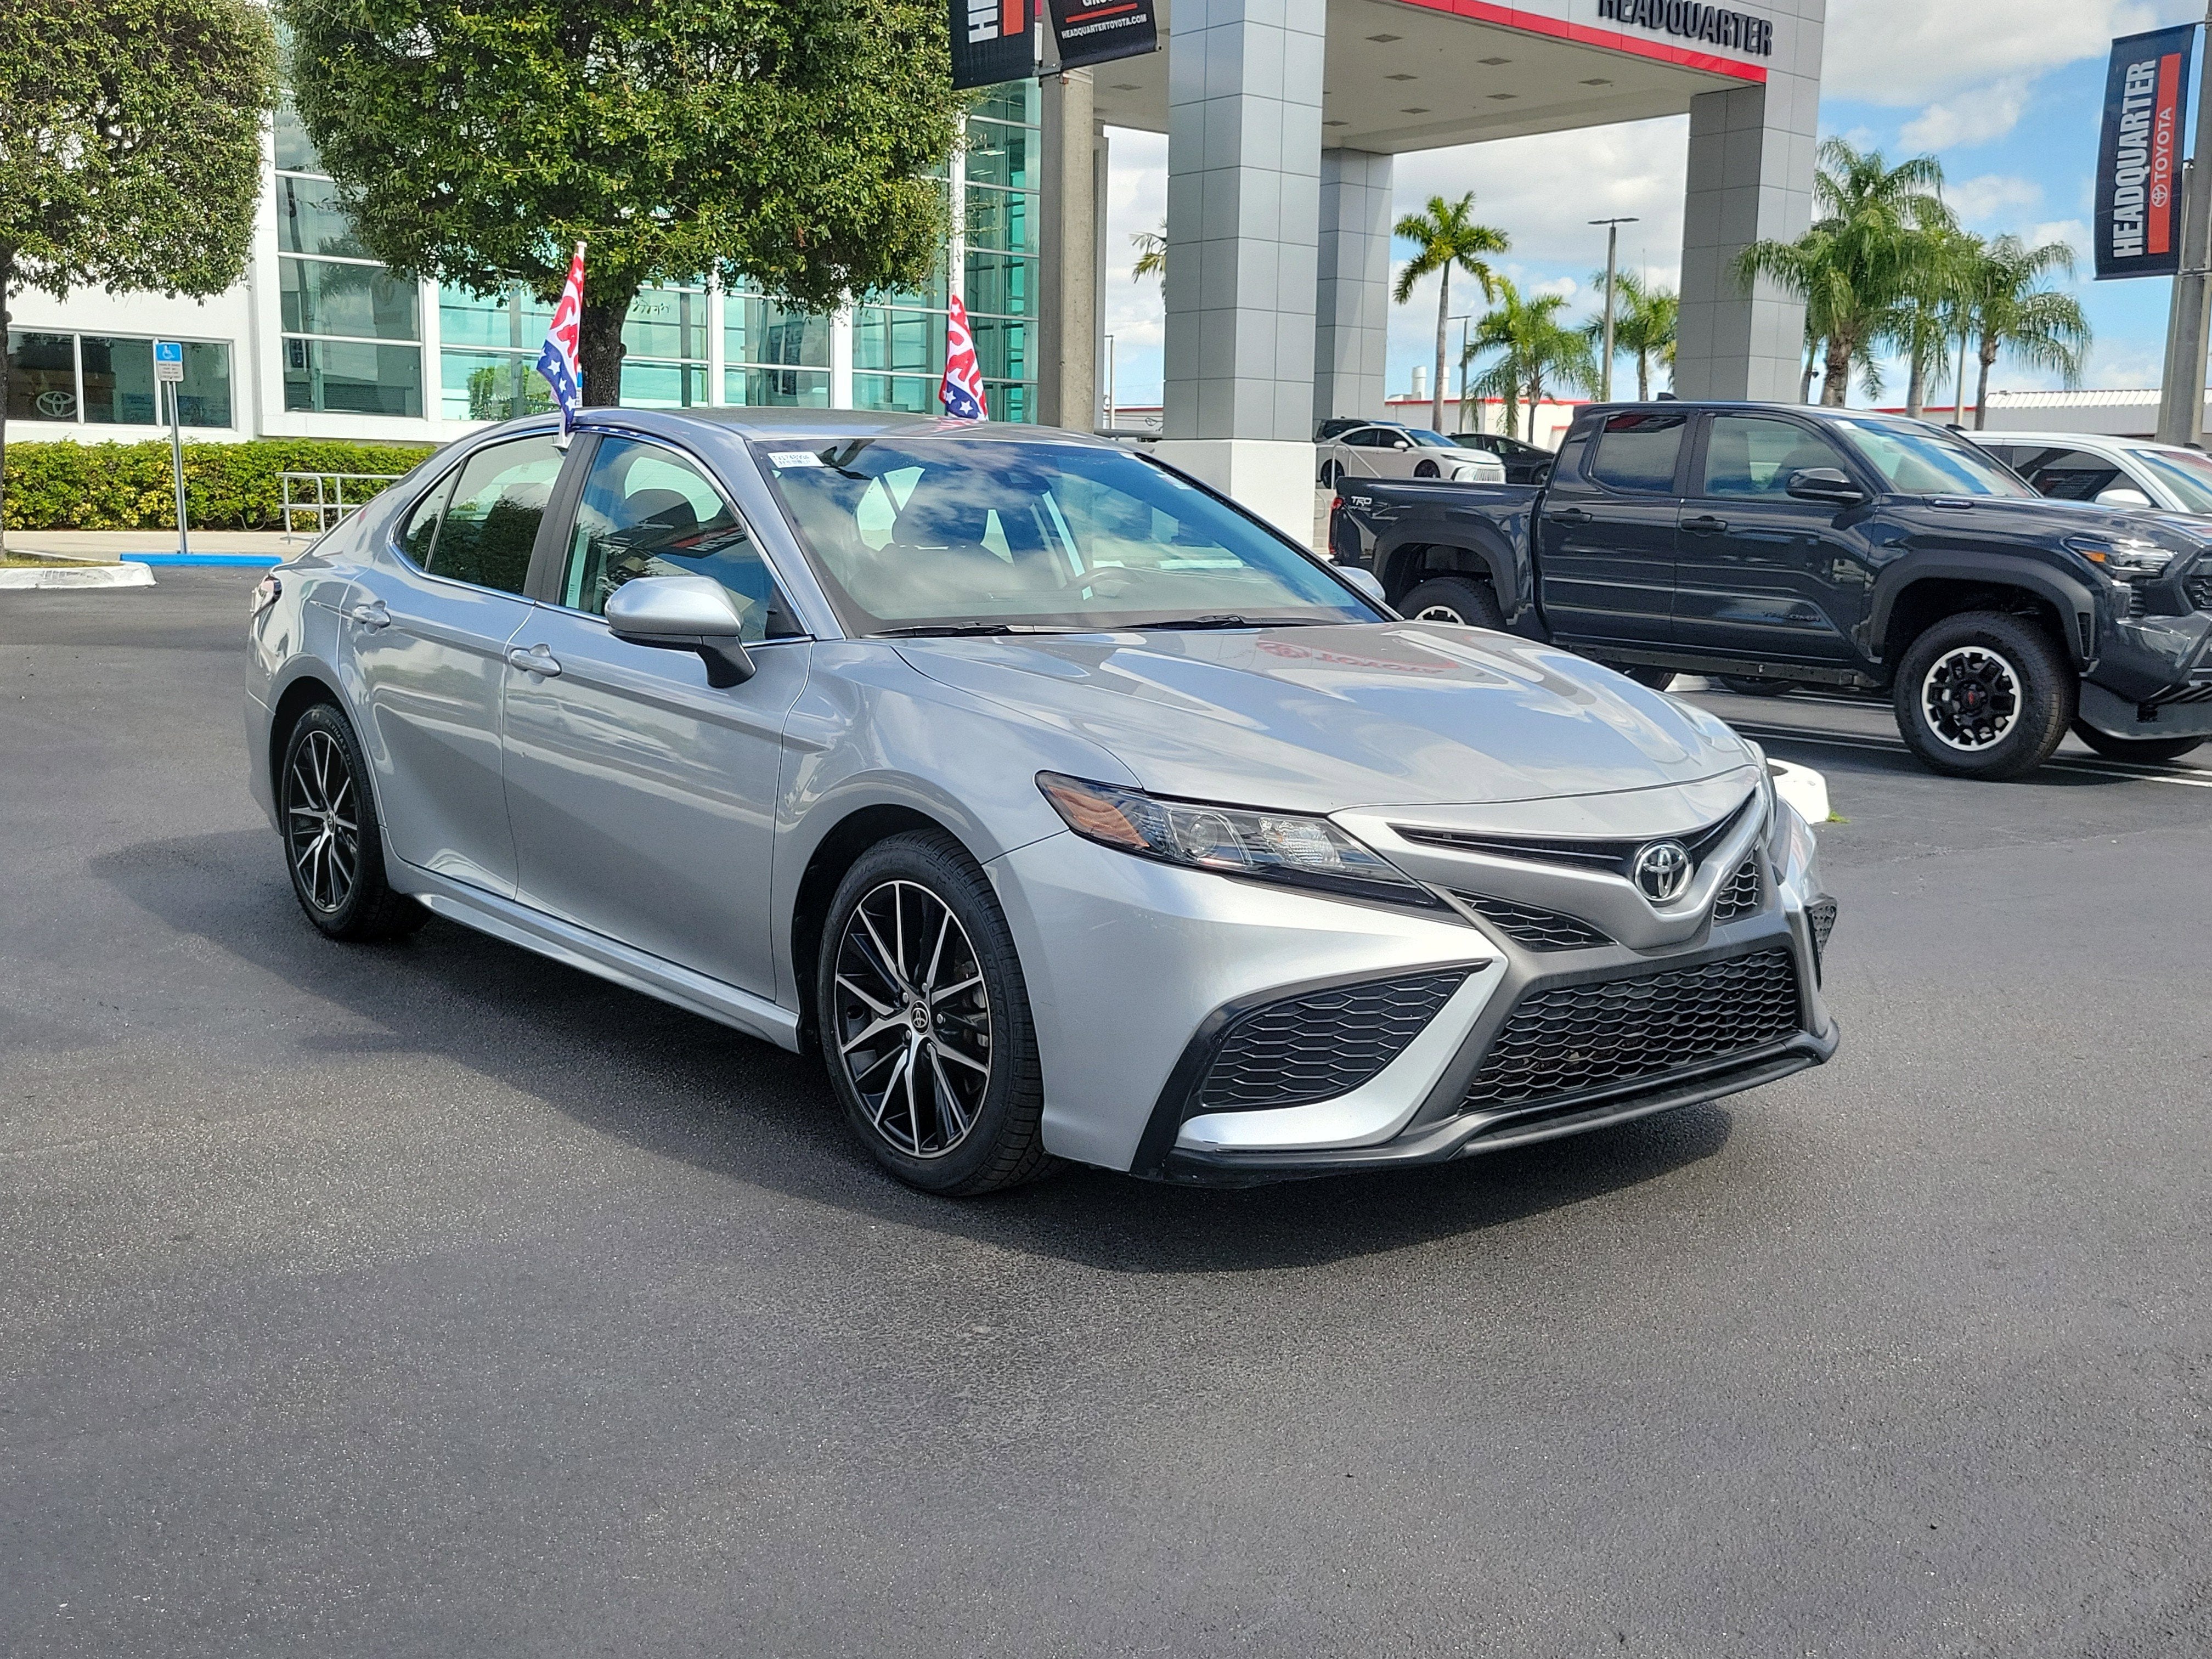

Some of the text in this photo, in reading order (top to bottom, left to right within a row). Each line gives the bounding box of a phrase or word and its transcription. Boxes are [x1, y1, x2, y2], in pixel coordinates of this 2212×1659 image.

[1062, 14, 1147, 39] HEADQUARTERTOYOTA.COM
[2113, 59, 2156, 257] HEADQUARTER
[2154, 107, 2171, 182] TOYOTA
[1351, 496, 1372, 506] TRD
